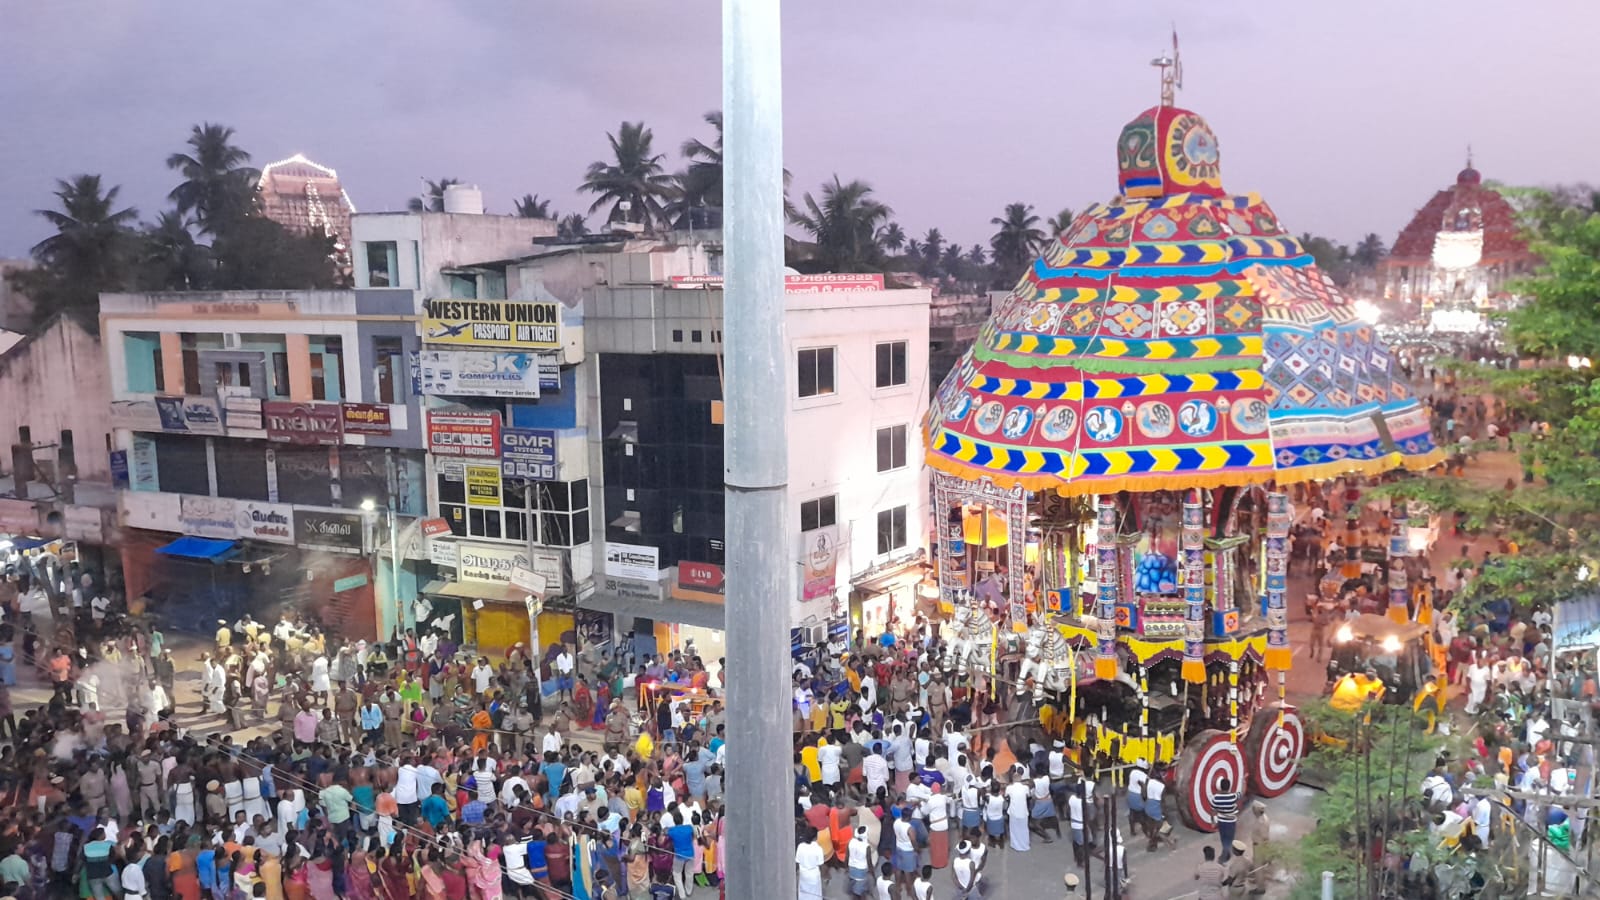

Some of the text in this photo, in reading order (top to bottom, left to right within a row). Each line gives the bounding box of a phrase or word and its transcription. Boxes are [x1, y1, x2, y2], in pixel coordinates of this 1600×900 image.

[428, 300, 556, 323] WESTERN UNION
[473, 323, 556, 343] PASSPORT AIR TICKET
[503, 434, 553, 448] GMR
[513, 446, 544, 454] SYSTEMS
[425, 523, 437, 534] ria
[697, 570, 711, 579] LVB
[605, 579, 617, 591] SB
